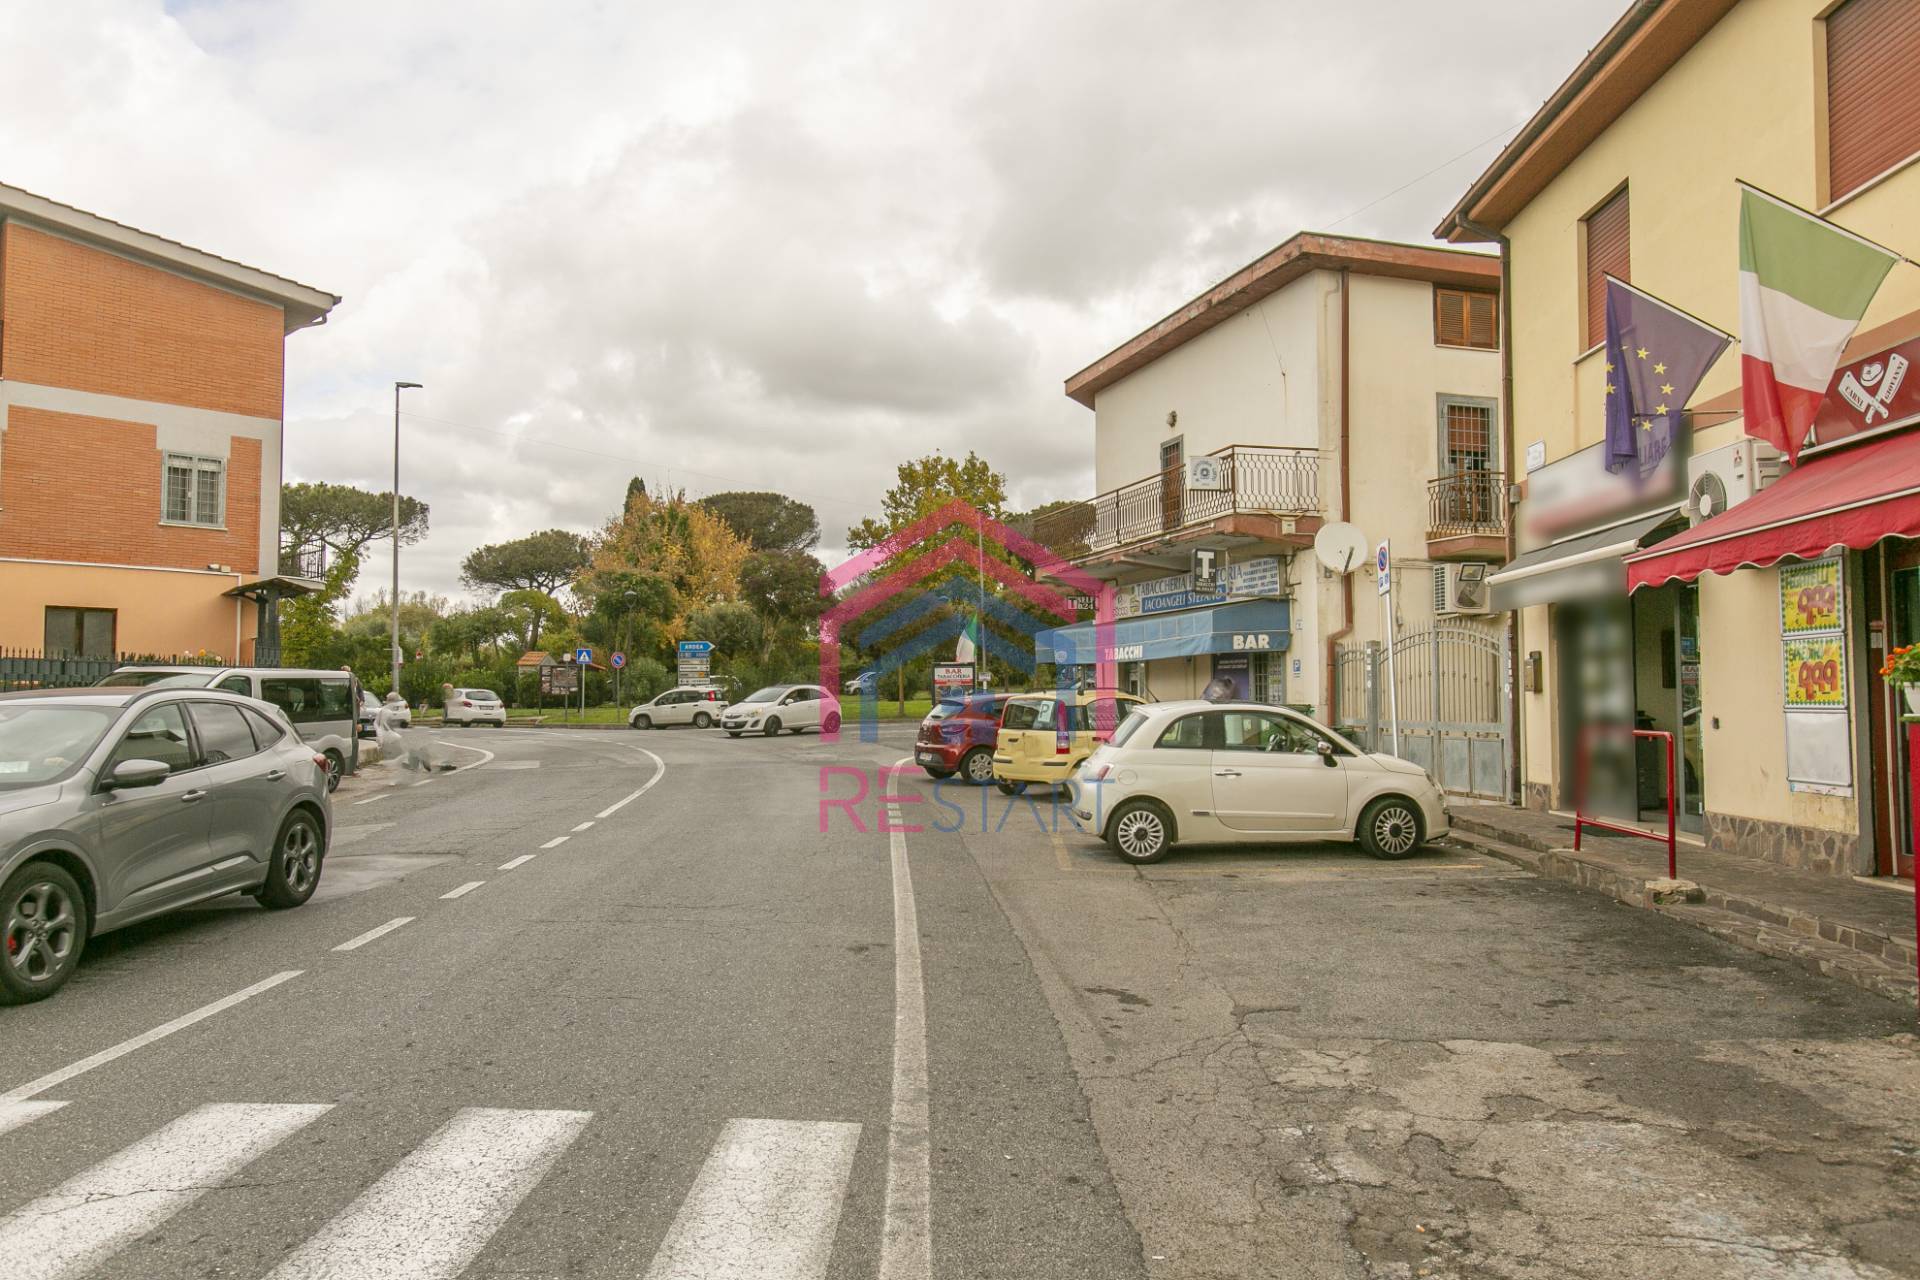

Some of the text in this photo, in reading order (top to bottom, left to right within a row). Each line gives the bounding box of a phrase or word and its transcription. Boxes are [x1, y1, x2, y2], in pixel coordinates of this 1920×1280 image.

[1884, 361, 1904, 400] GIOVANNI
[1845, 386, 1864, 407] CARNI
[1197, 551, 1215, 578] T
[1135, 574, 1186, 597] TABACCHERIA
[1104, 645, 1143, 660] TABACCHI
[1233, 634, 1270, 650] BAR
[1040, 704, 1050, 718] P
